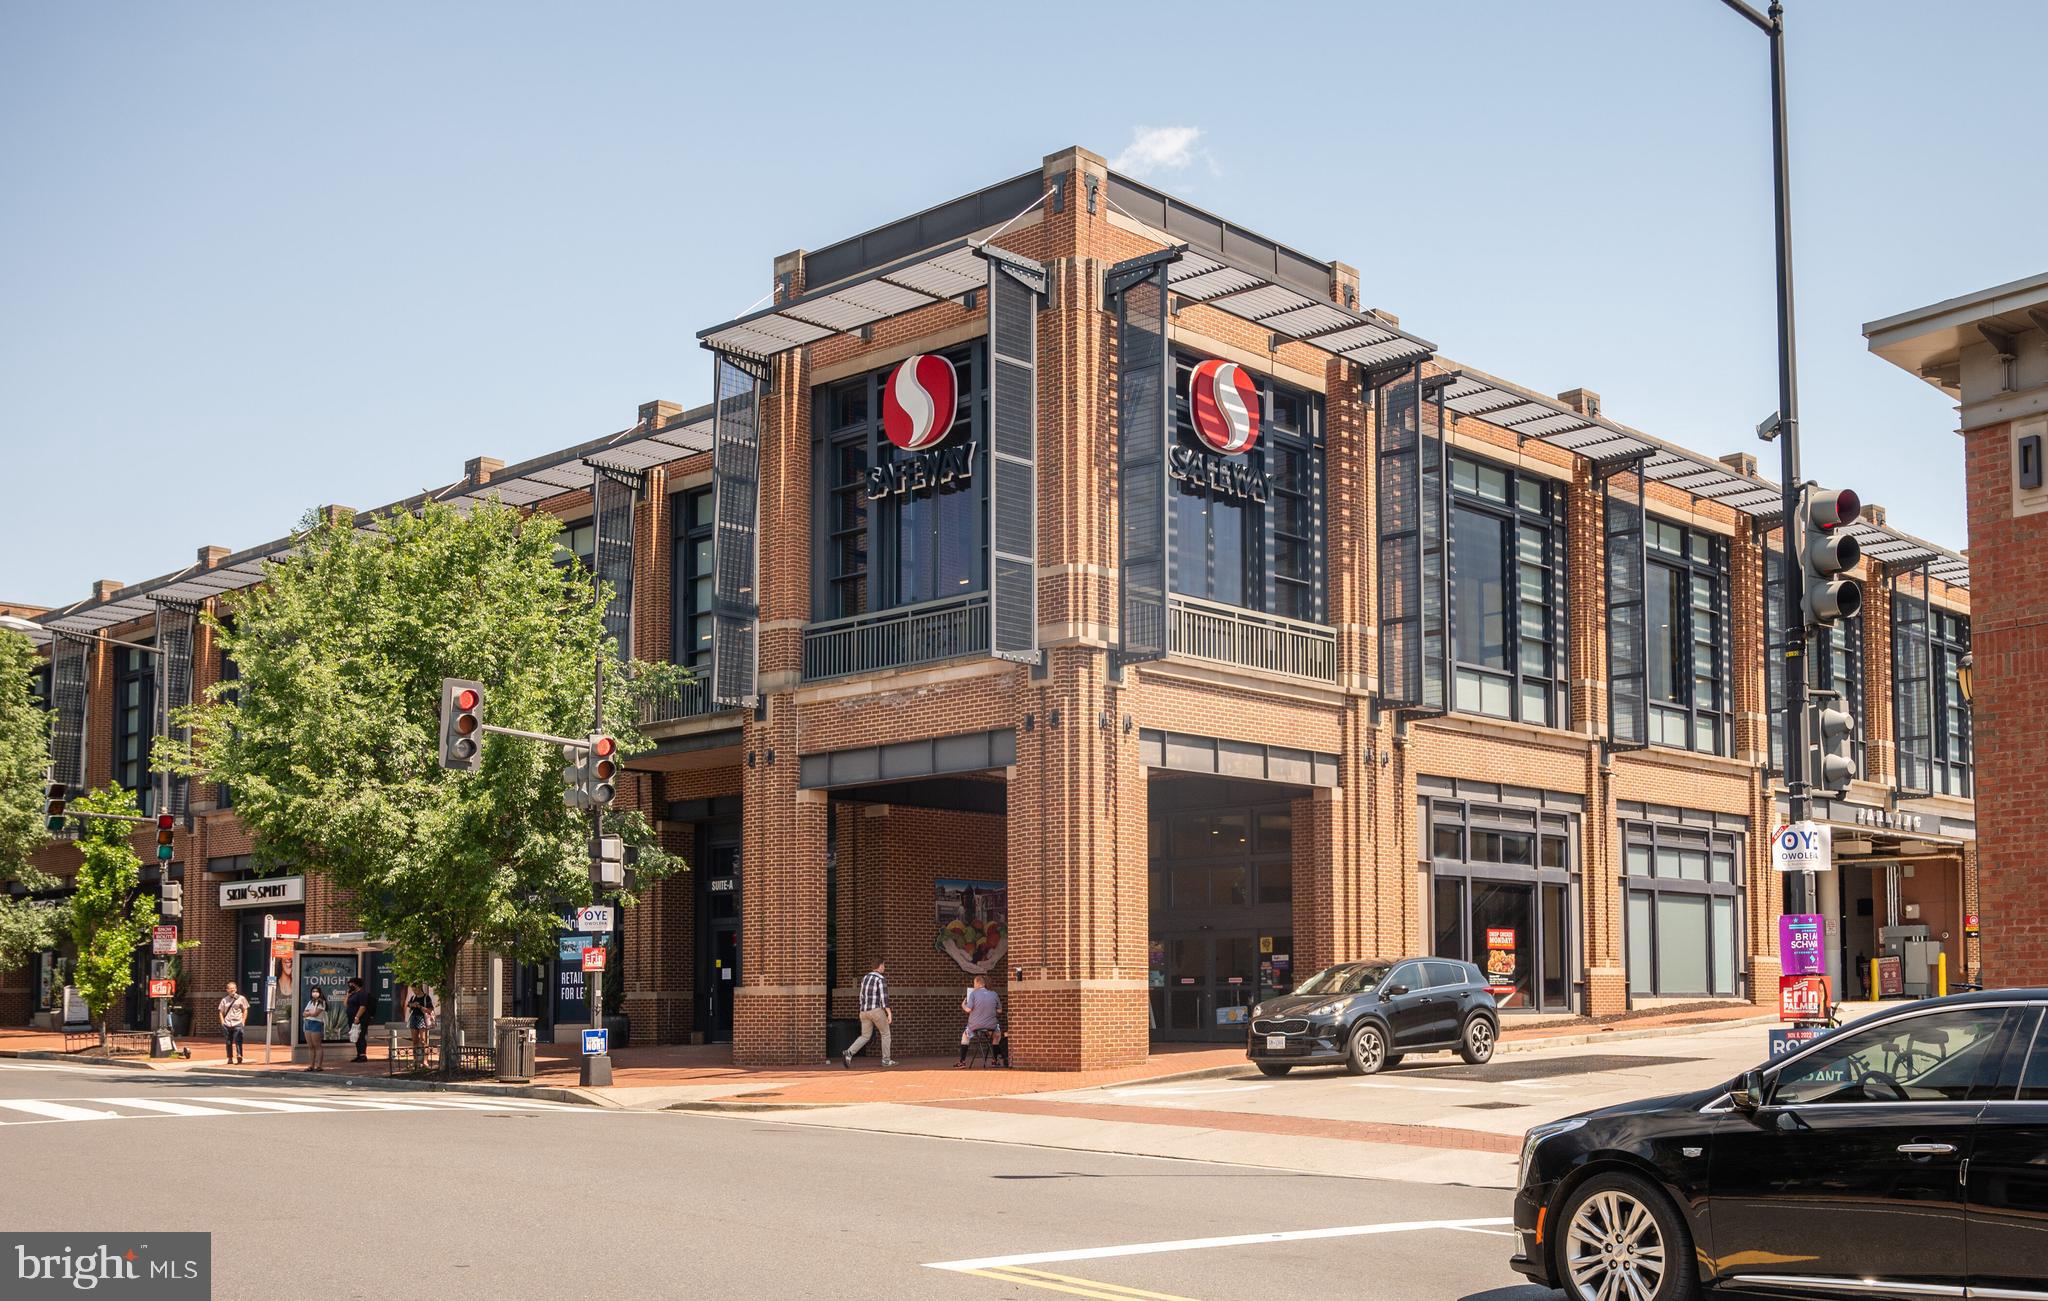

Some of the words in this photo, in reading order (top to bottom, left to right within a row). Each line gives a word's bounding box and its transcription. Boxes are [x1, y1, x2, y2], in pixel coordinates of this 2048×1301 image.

[866, 441, 976, 500] SAFEWAY
[1169, 446, 1275, 503] SAFEWAY
[227, 888, 247, 901] SKIN
[258, 884, 287, 899] SPIRIT
[711, 880, 734, 891] SUITE-A
[584, 911, 608, 921] OYE
[561, 971, 584, 985] RETAIL
[561, 987, 575, 1000] FOR
[576, 987, 585, 1000] LE
[1783, 986, 1818, 1003] Erin
[1783, 1002, 1818, 1010] PALMER
